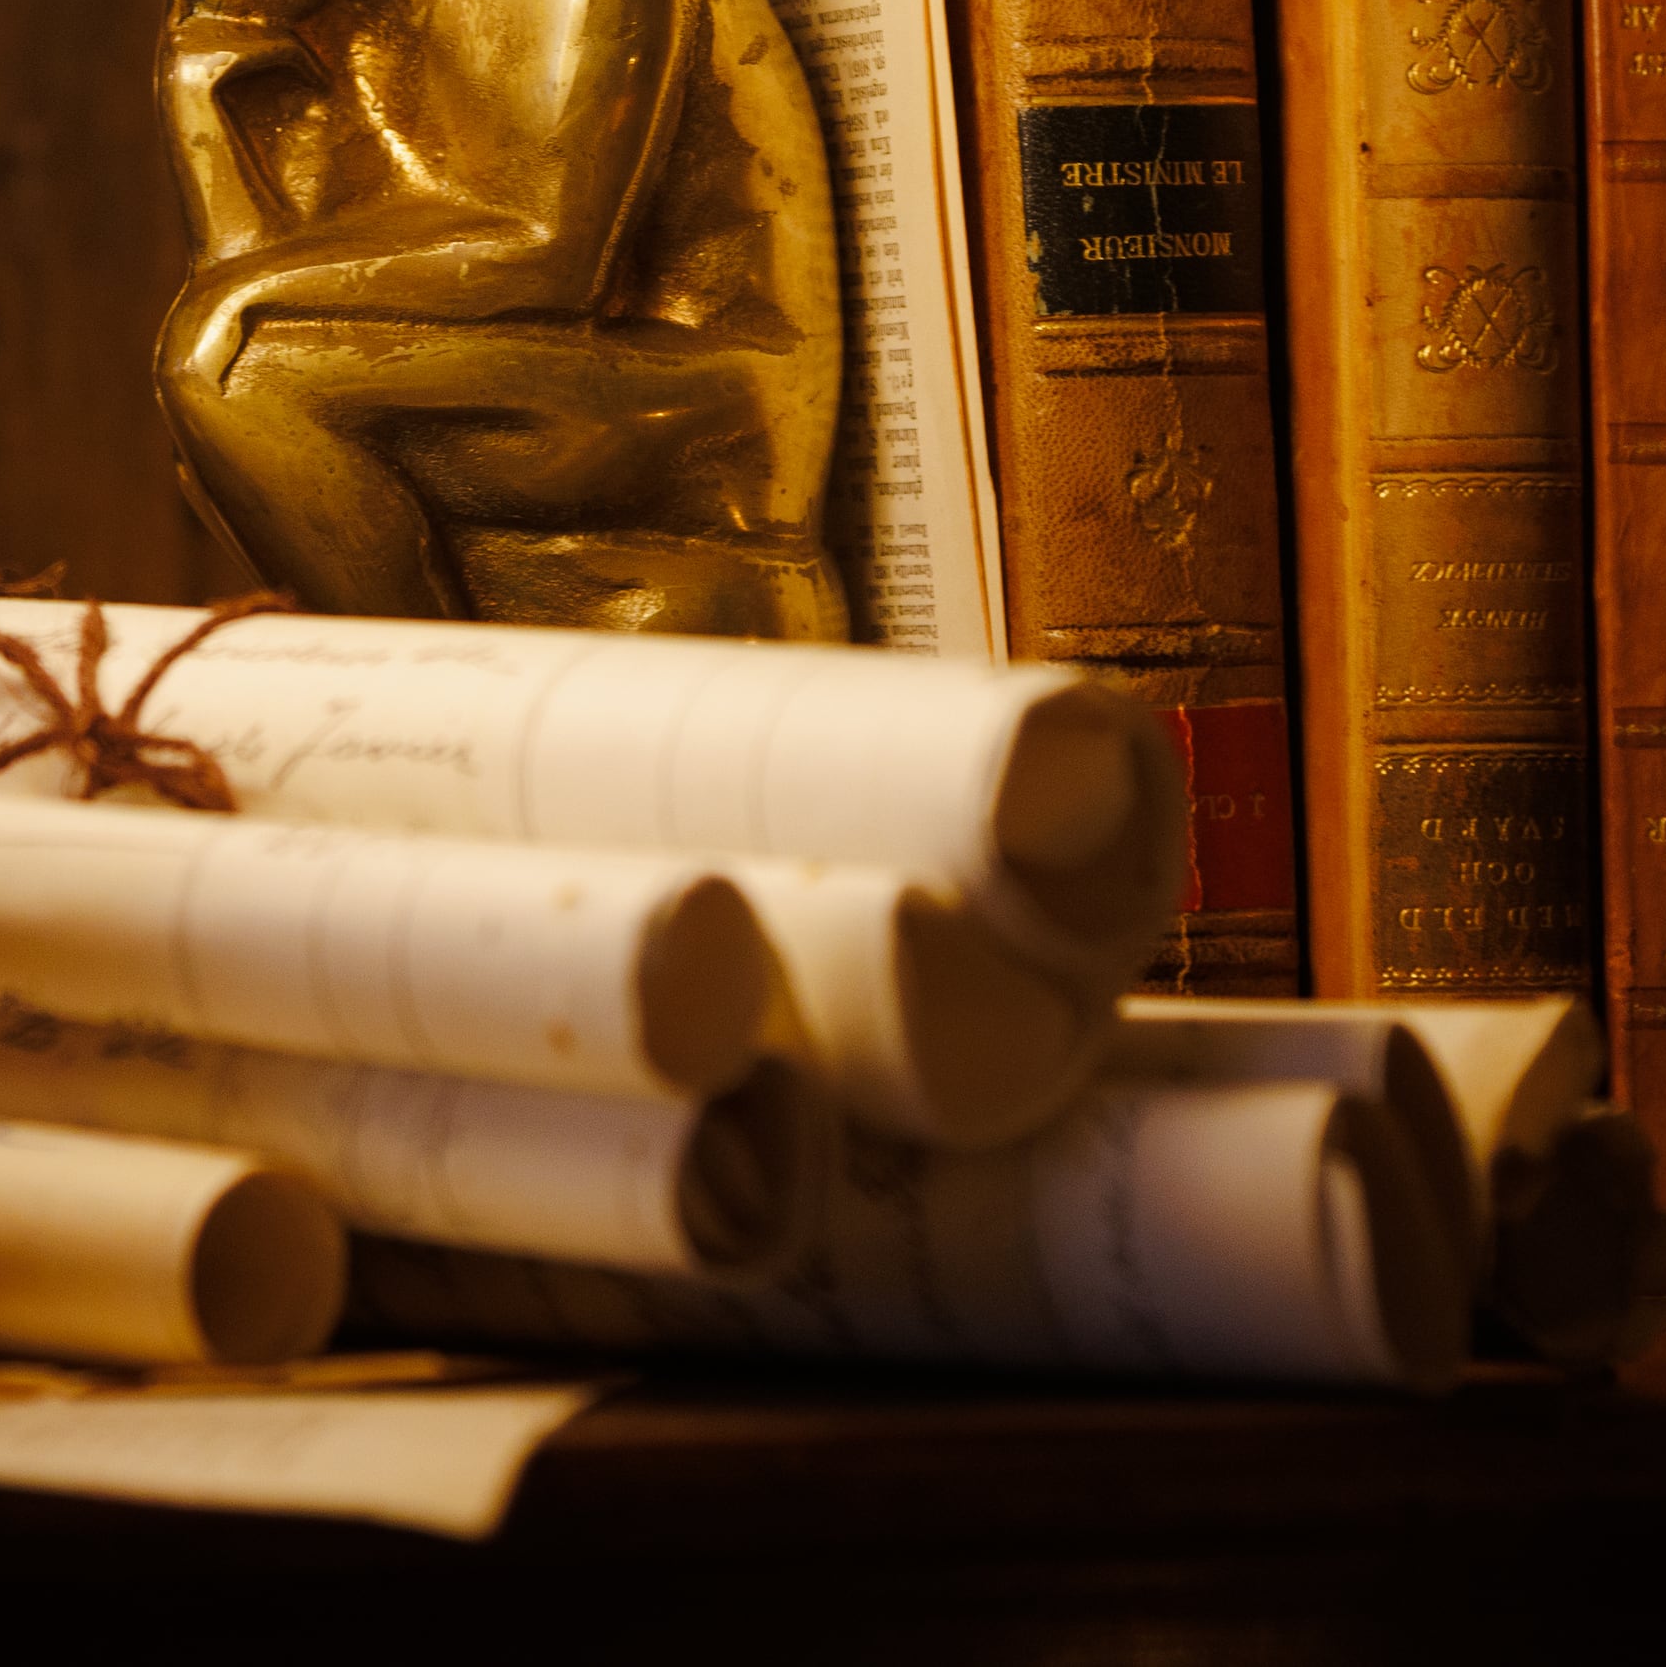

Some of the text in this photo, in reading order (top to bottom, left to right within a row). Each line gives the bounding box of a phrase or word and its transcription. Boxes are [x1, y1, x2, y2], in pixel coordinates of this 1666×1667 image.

[1059, 160, 1245, 187] LE MINISTRE
[1079, 232, 1234, 261] MONSIEUR
[1459, 860, 1535, 886] OCH
[1398, 906, 1485, 932] ELD
